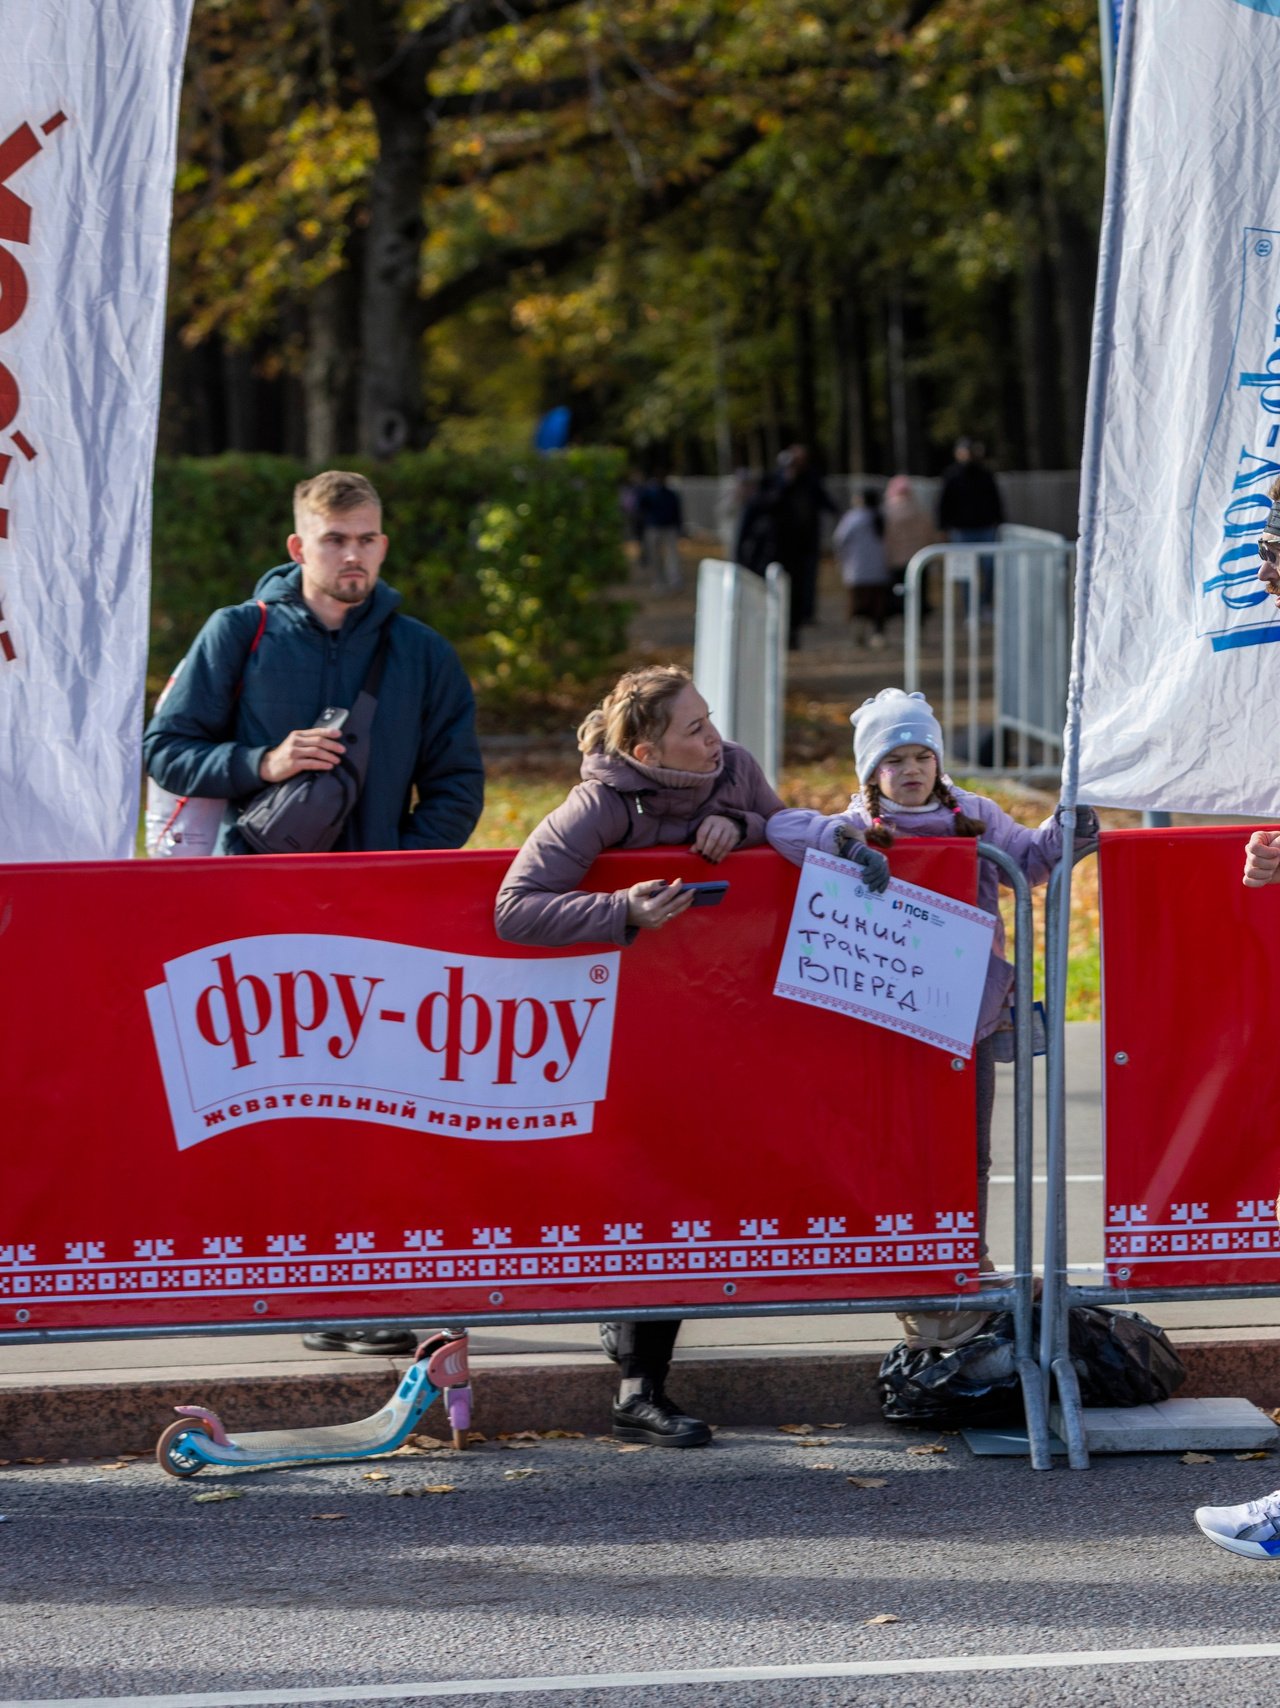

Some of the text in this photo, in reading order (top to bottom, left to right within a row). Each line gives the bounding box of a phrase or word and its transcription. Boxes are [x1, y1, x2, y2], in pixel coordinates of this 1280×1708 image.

[904, 903, 930, 922] ПСБ
[195, 953, 606, 1085] фру-фру
[203, 1091, 578, 1132] жевательный мармелад
